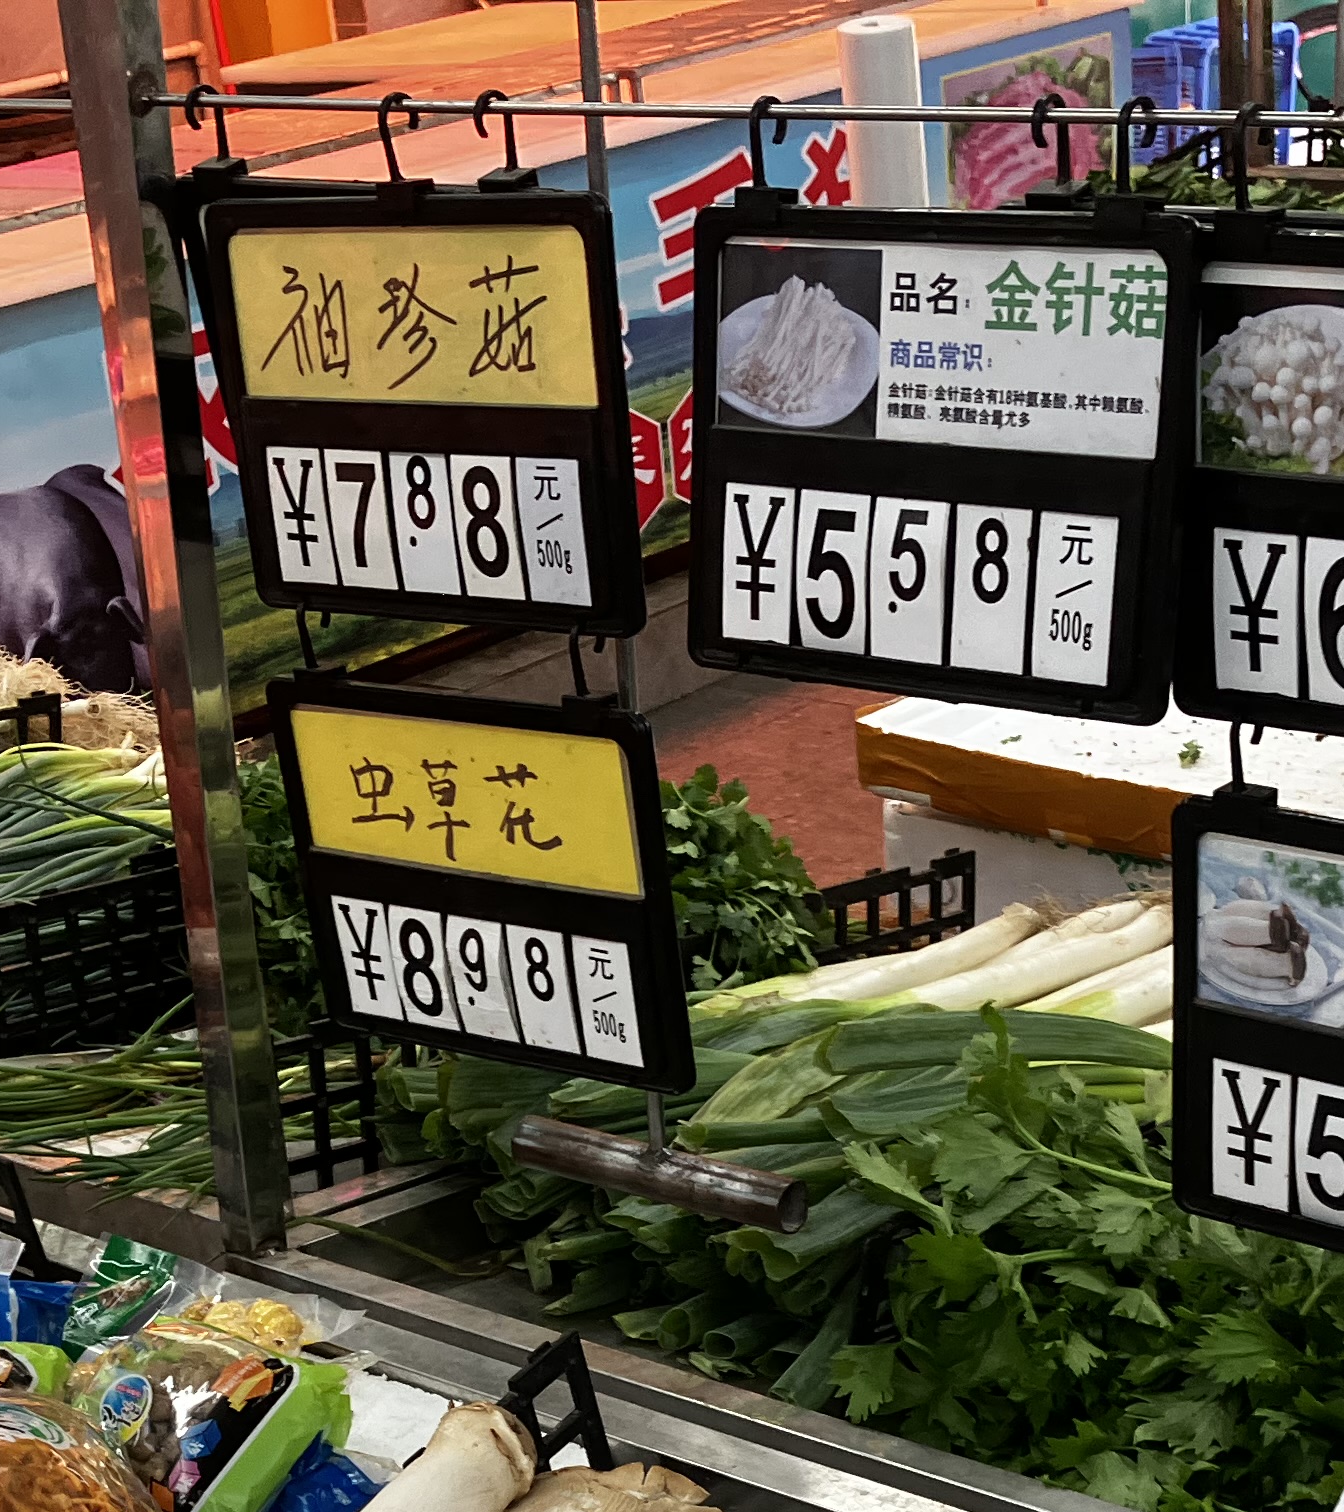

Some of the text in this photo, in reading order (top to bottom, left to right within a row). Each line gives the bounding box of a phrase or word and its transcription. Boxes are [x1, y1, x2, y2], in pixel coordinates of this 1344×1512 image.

[984, 260, 1168, 340] 金针菇
[348, 756, 563, 861] 虫草花
